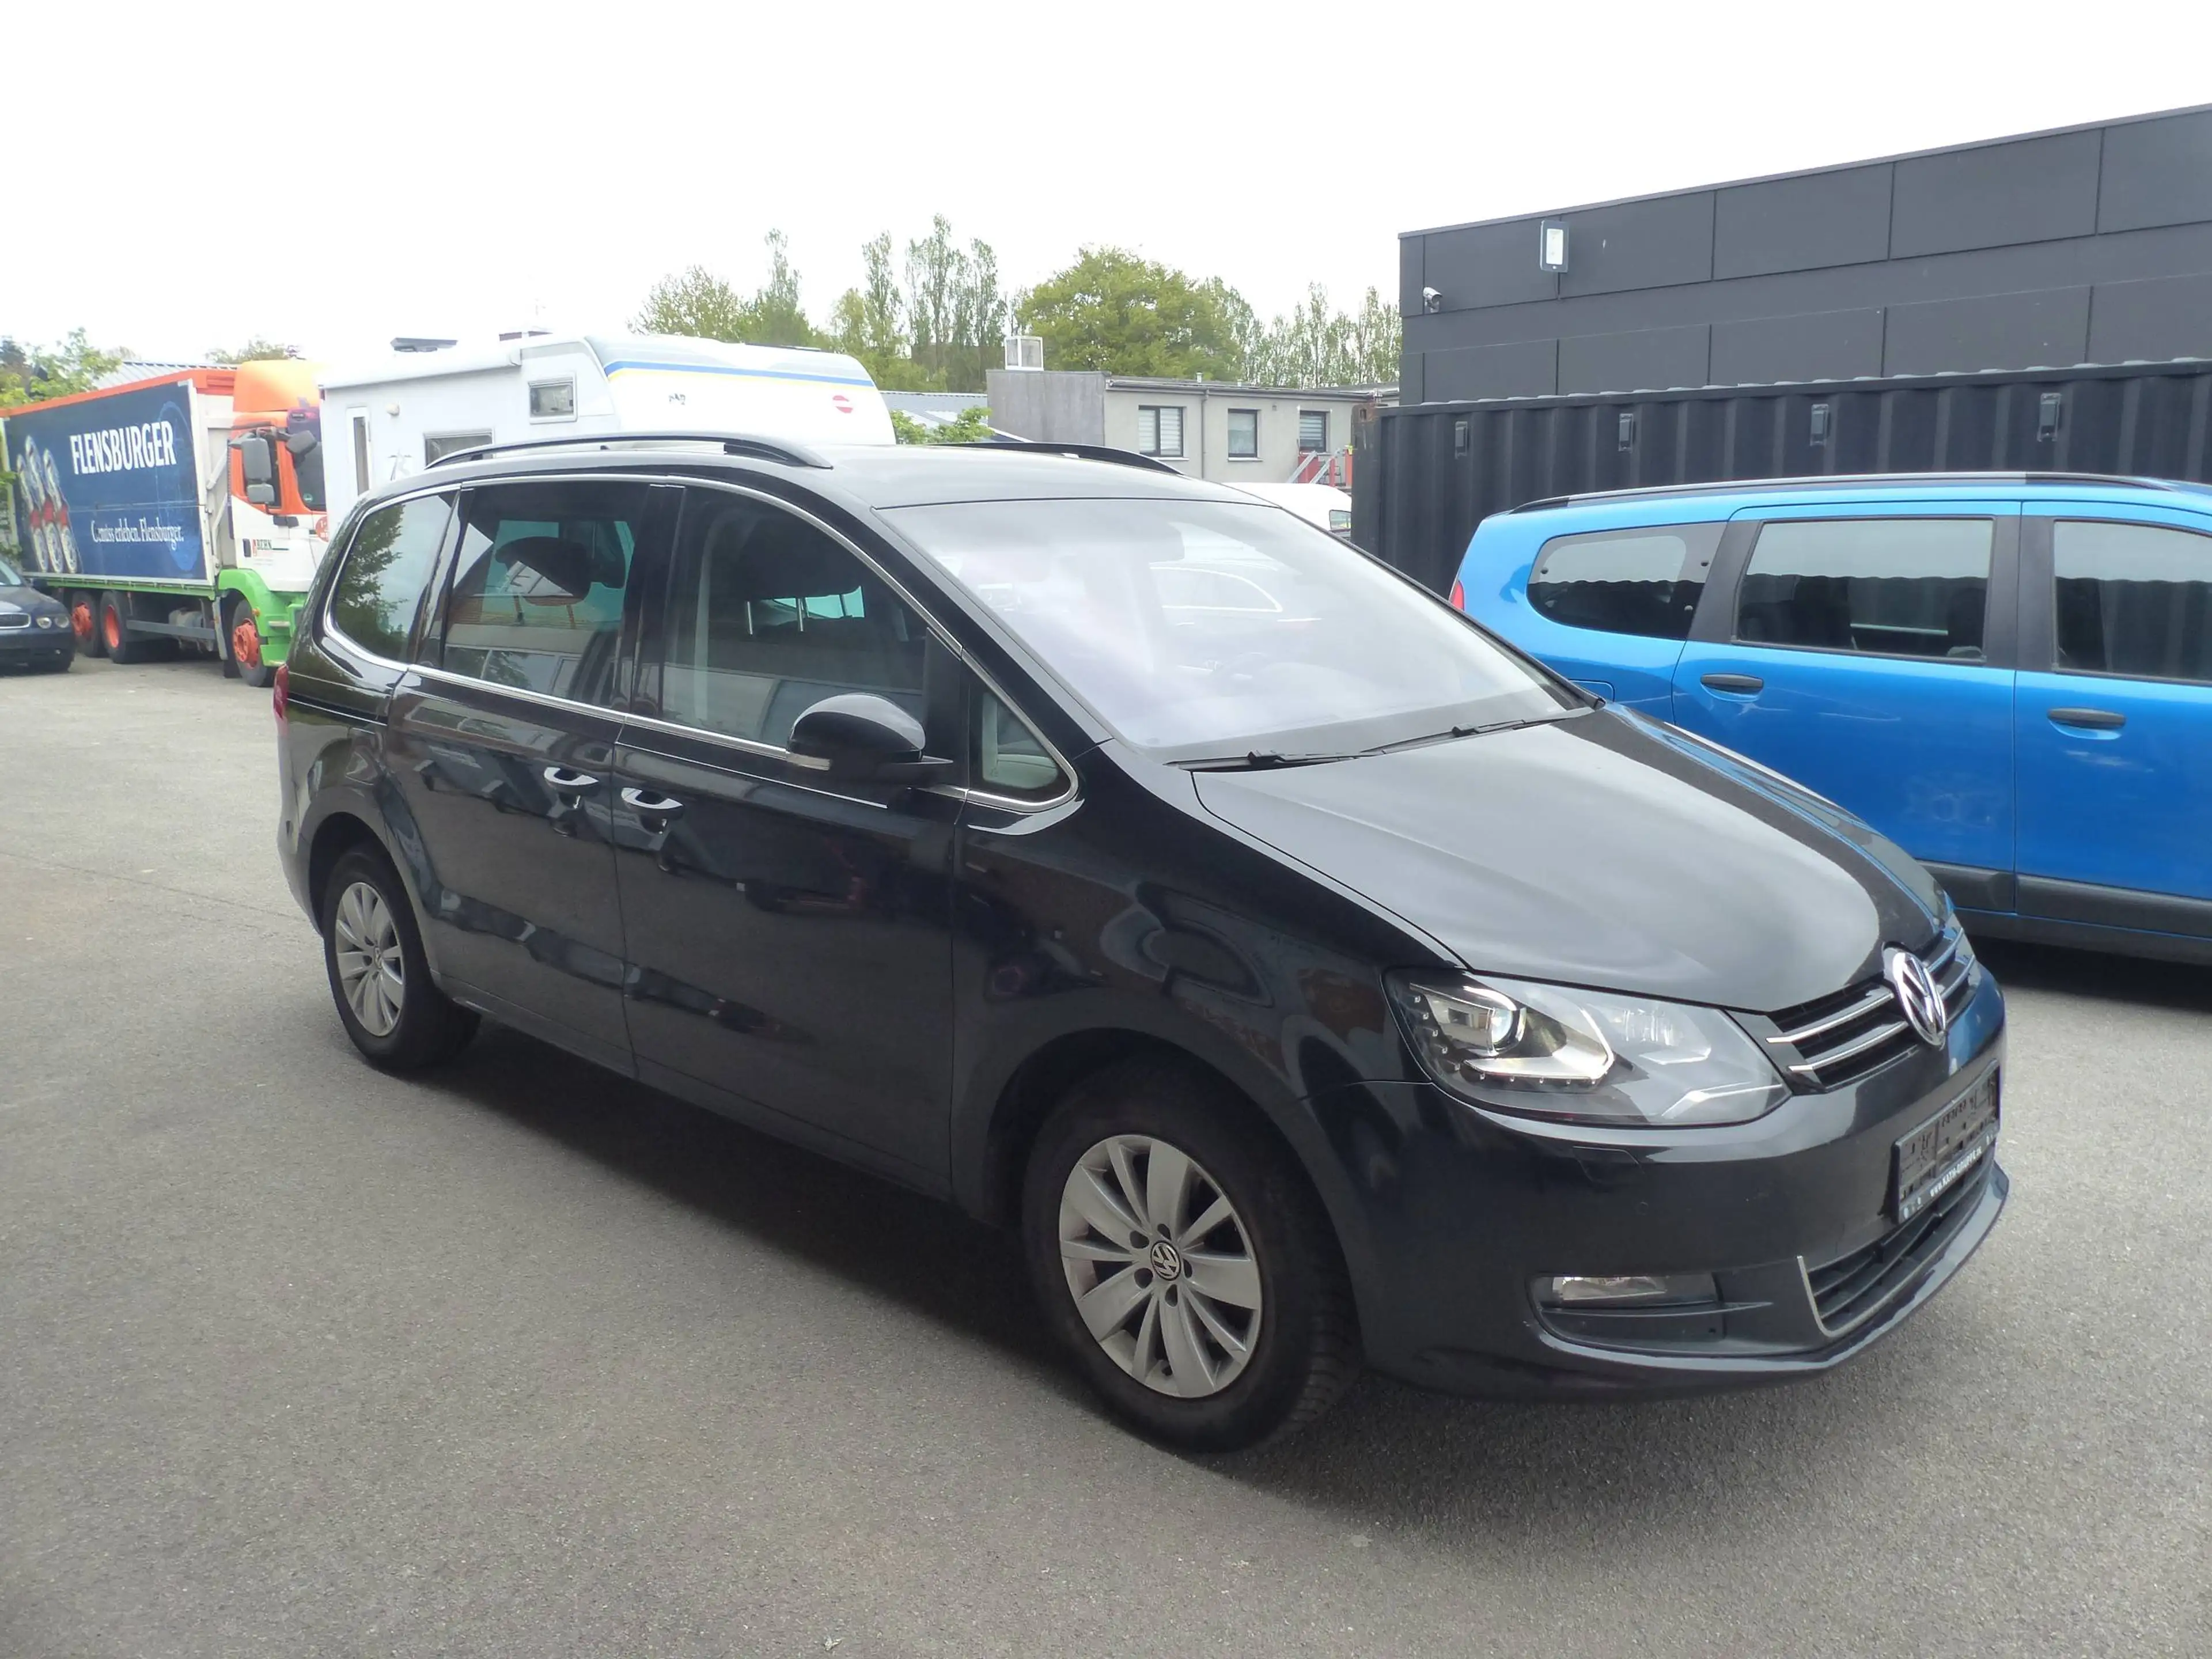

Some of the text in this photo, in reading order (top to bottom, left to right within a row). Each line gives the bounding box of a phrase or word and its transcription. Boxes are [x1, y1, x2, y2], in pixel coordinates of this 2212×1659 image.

[70, 420, 177, 475] FLENSBURGER
[139, 517, 184, 550] Flensburger.
[1152, 1241, 1180, 1279] VW
